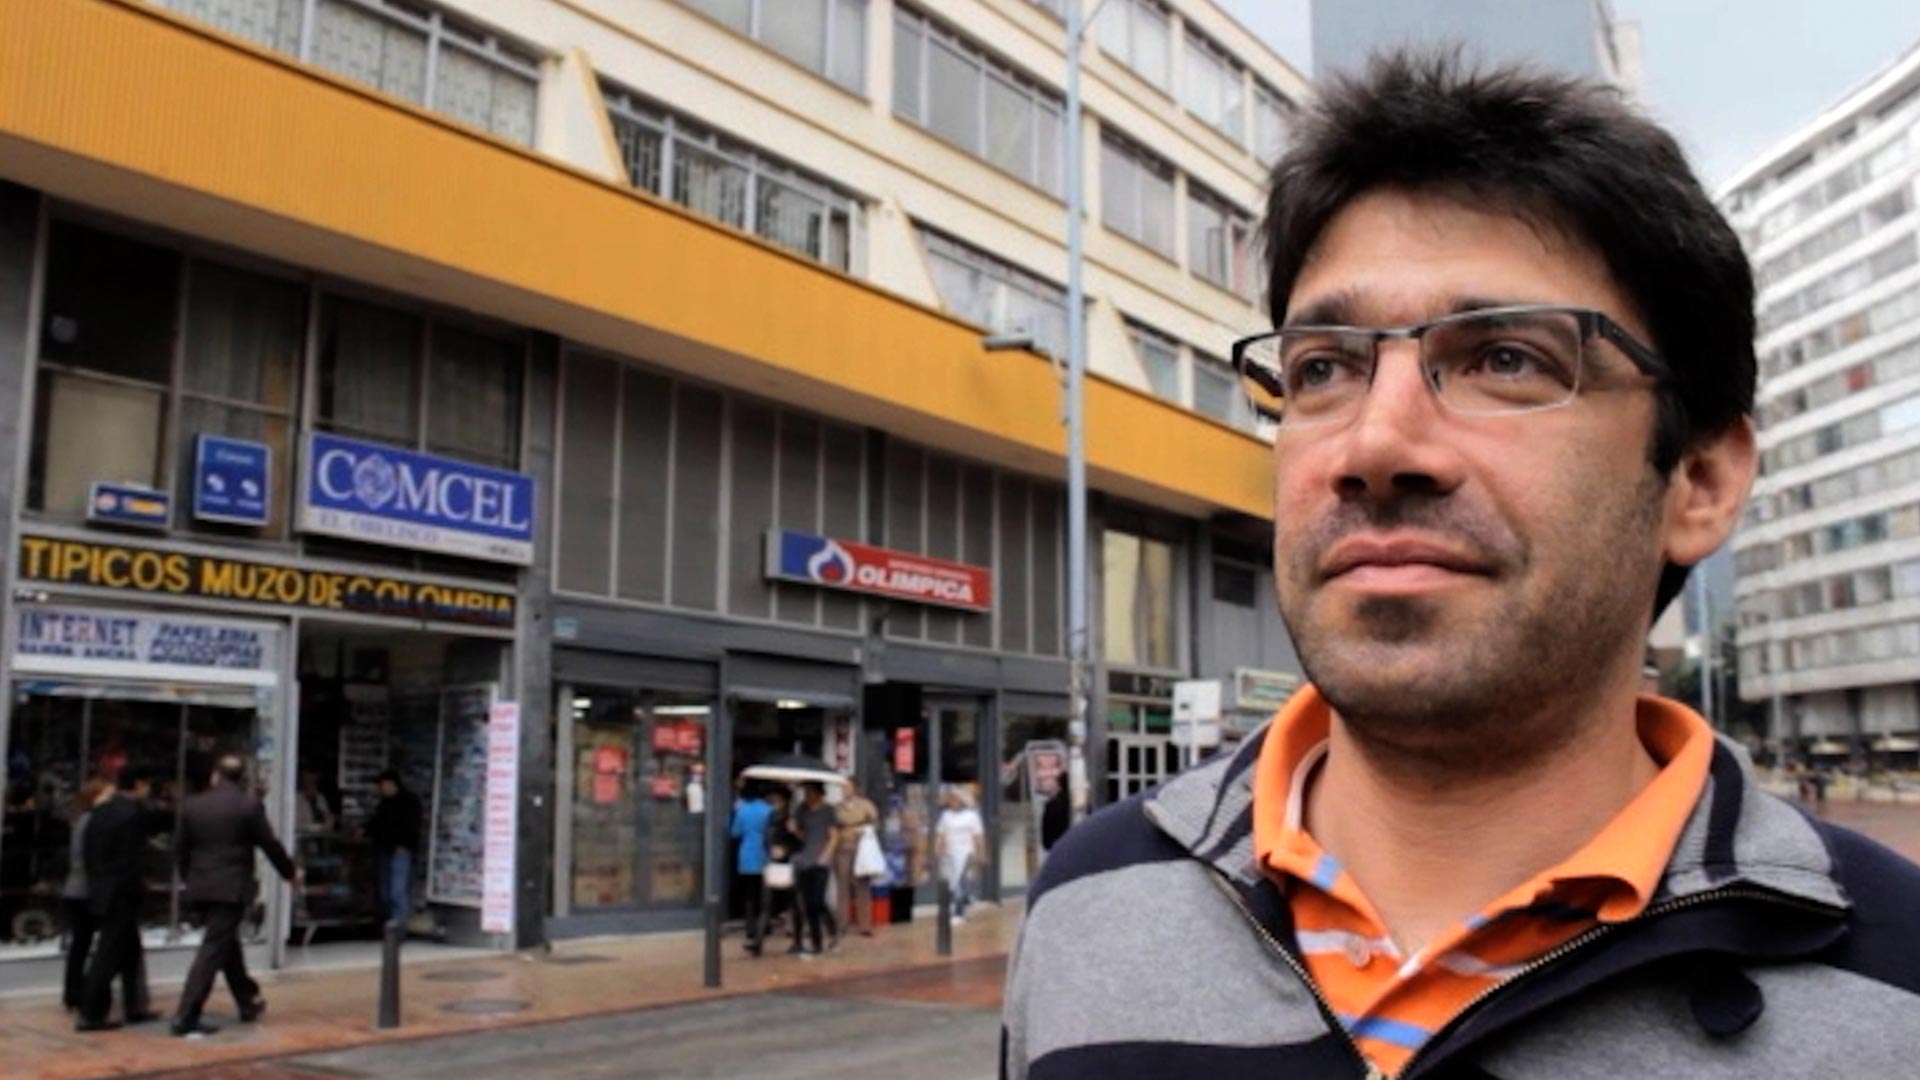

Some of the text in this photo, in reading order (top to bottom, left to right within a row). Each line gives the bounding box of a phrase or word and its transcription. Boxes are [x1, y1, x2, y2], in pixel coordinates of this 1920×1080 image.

[318, 449, 528, 531] COMCEL
[23, 539, 190, 592] TIPICOS
[200, 560, 306, 605] MUZO
[308, 573, 344, 608] DE
[856, 564, 974, 602] OLIMPICA
[19, 612, 138, 644] INTERNET
[159, 622, 259, 643] PAPELERIA
